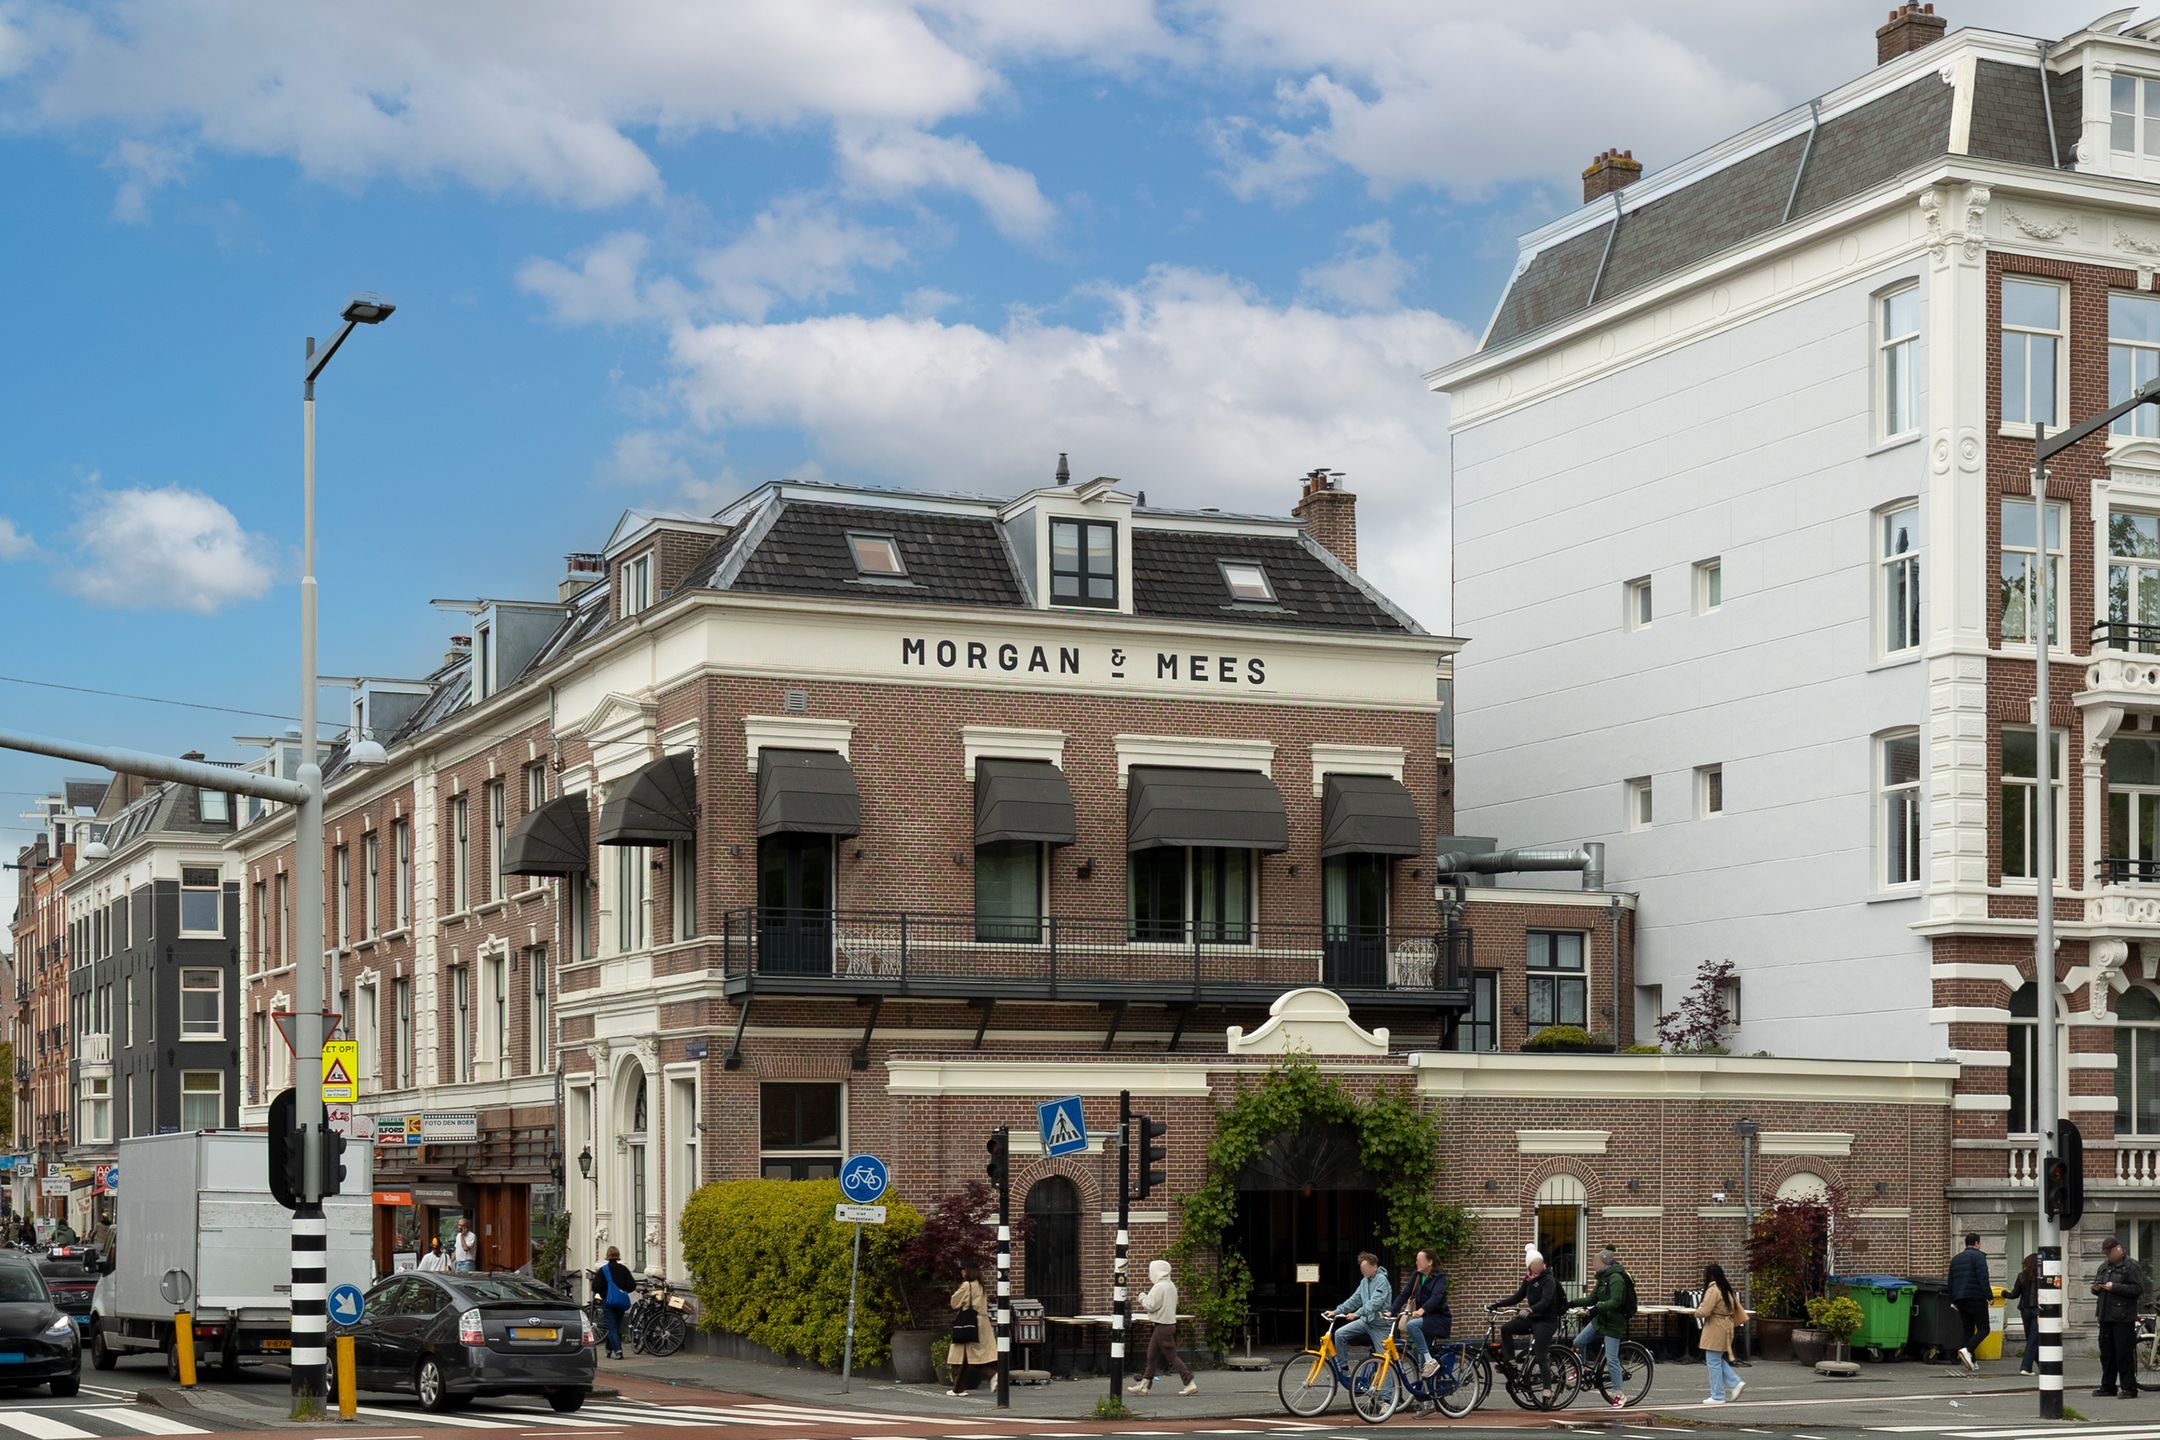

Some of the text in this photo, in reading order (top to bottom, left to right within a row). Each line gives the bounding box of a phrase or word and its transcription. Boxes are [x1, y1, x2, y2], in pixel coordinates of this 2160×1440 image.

[902, 638, 1266, 685] MORGAN & MEES
[338, 1045, 355, 1053] OP!
